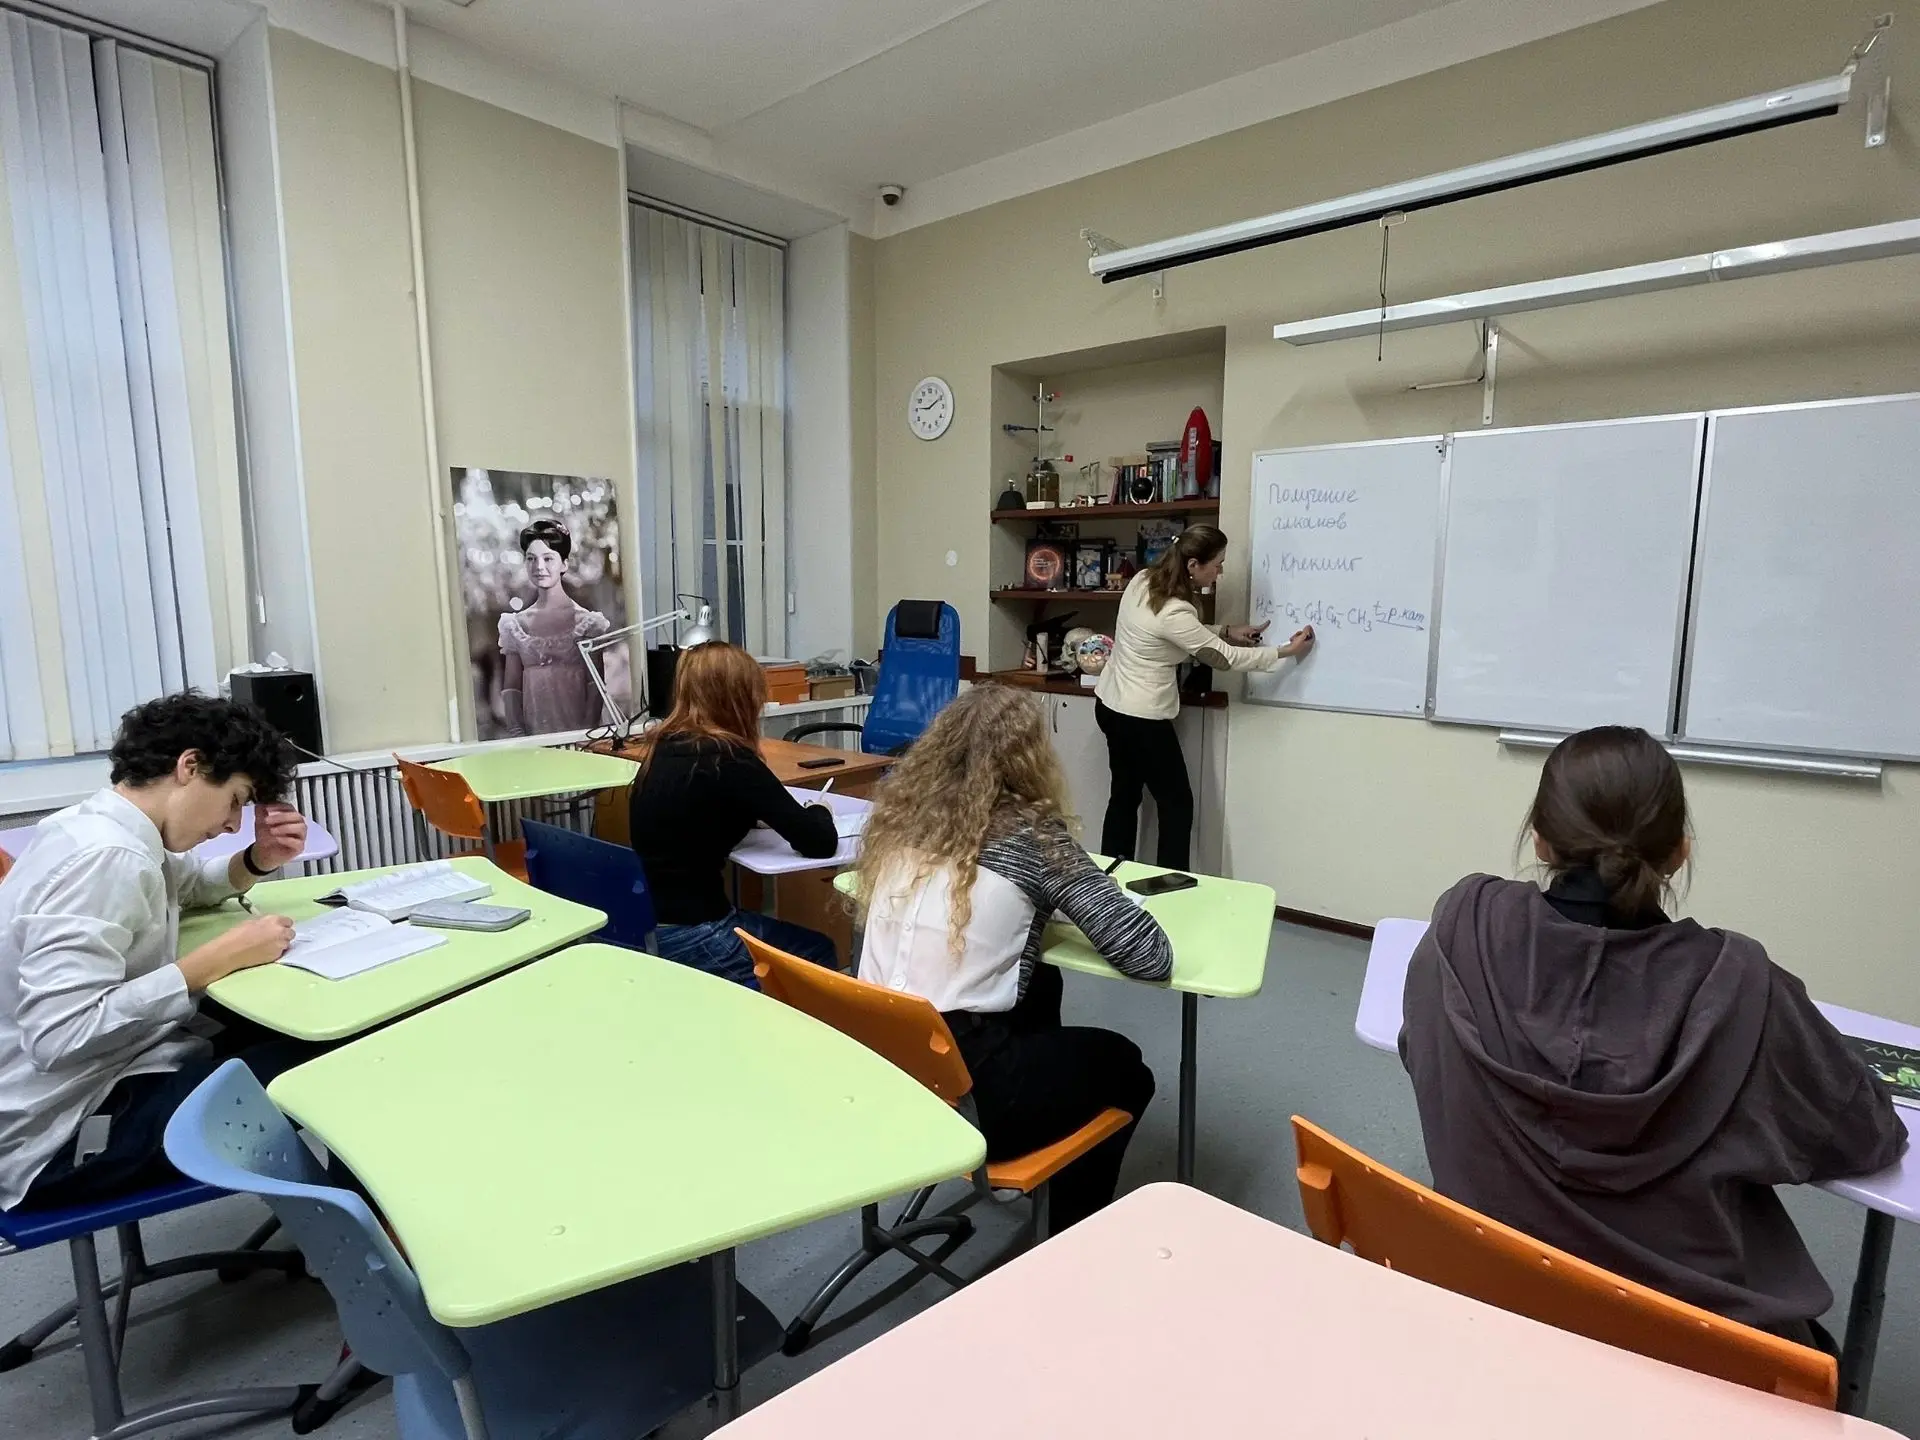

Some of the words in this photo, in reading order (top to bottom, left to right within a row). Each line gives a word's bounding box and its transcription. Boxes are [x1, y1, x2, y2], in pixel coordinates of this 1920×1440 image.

[1269, 483, 1360, 510] Получение
[1272, 512, 1348, 531] алканов
[1280, 550, 1363, 579] Крекинг
